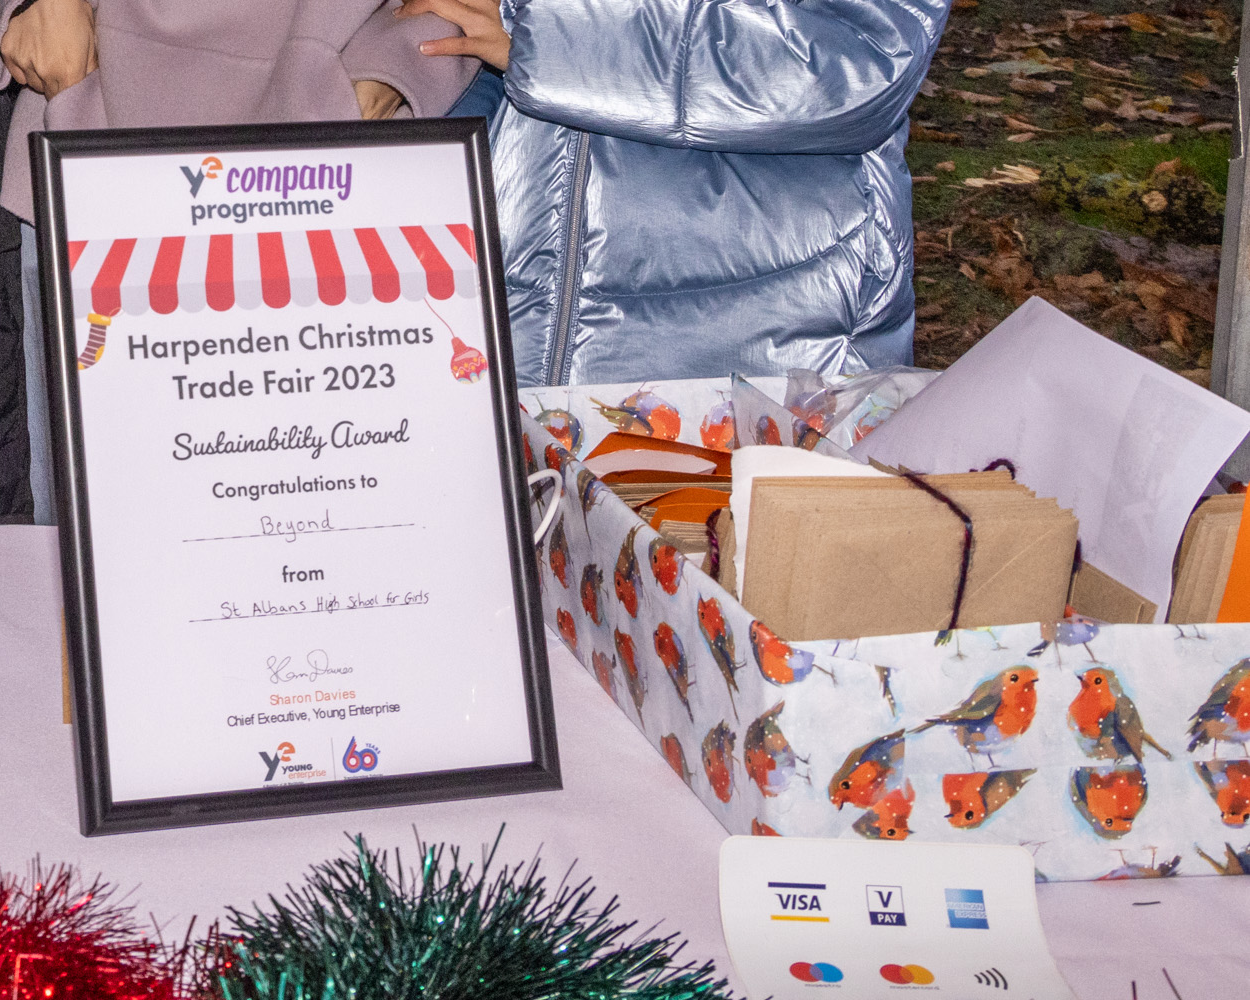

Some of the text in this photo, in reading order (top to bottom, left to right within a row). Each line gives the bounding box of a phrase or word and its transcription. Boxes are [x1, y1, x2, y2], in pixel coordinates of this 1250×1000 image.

[226, 163, 352, 201] company
[190, 199, 334, 226] programme
[127, 323, 434, 365] Harpenden Christmas
[171, 363, 396, 400] Trade Fair 2023
[172, 418, 410, 461] Sustainability Award
[212, 474, 378, 501] Congratulations to
[260, 508, 335, 543] Beyond
[281, 565, 325, 583] from
[220, 601, 241, 619] St
[252, 599, 307, 617] Albans
[346, 593, 378, 609] School
[269, 689, 356, 706] Sharon Davies
[227, 702, 401, 727] Chief Executive, Young Enterprise
[281, 763, 313, 775] YOUNG
[288, 769, 327, 780] enterprise
[774, 893, 822, 912] VISA
[873, 890, 893, 909] V
[946, 902, 984, 911] AMERICAN
[877, 914, 898, 924] PAY
[955, 911, 987, 919] EXPRESS
